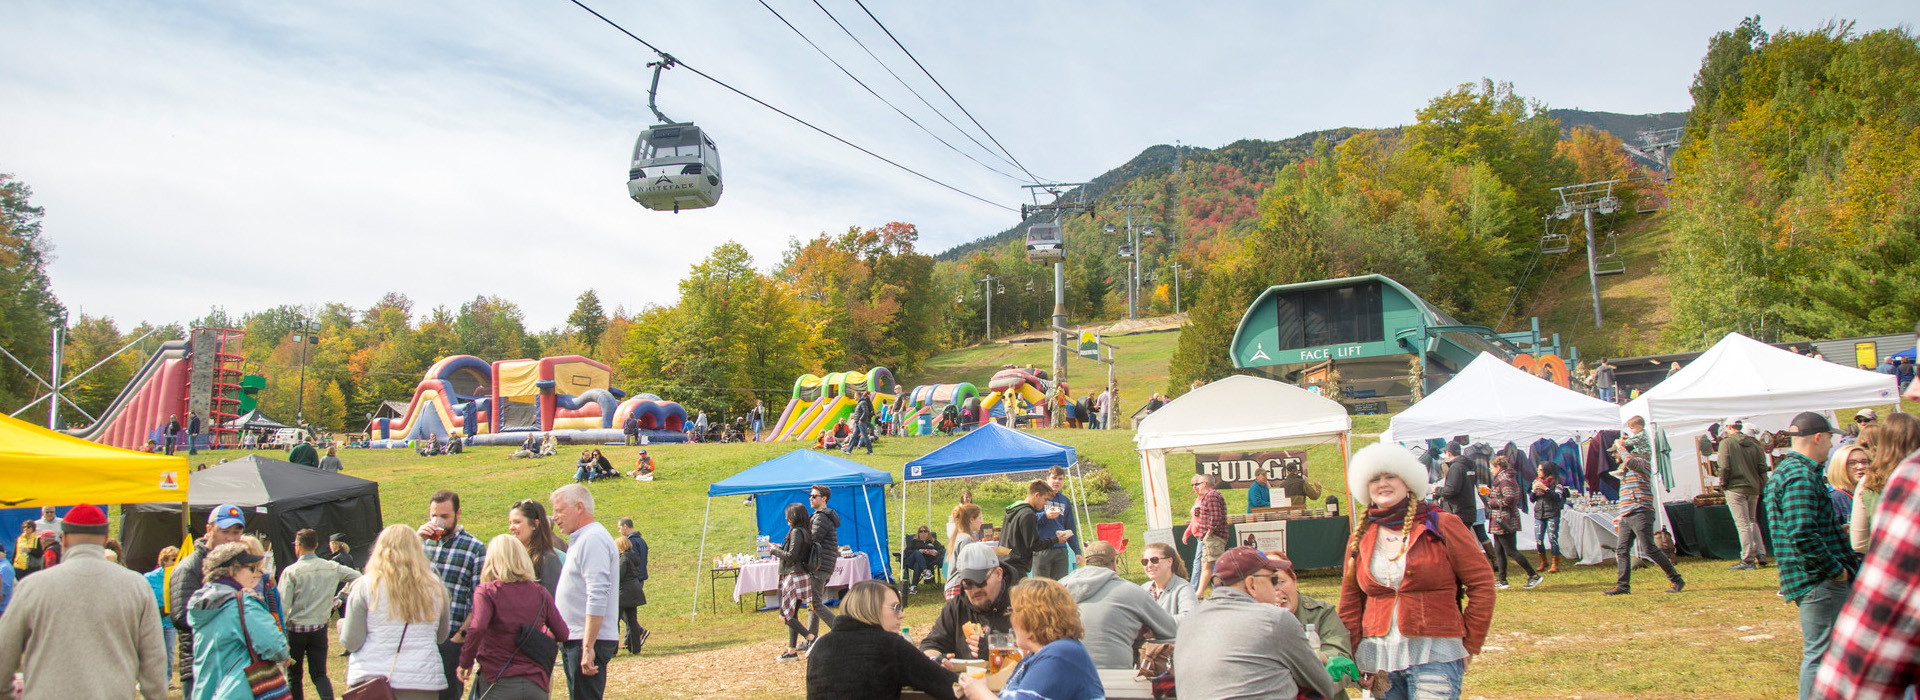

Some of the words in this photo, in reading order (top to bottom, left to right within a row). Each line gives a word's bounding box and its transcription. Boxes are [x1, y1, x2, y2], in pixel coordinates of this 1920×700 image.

[637, 182, 694, 192] WHITEFACE
[1300, 348, 1329, 360] FACE
[1338, 345, 1362, 357] LIFT
